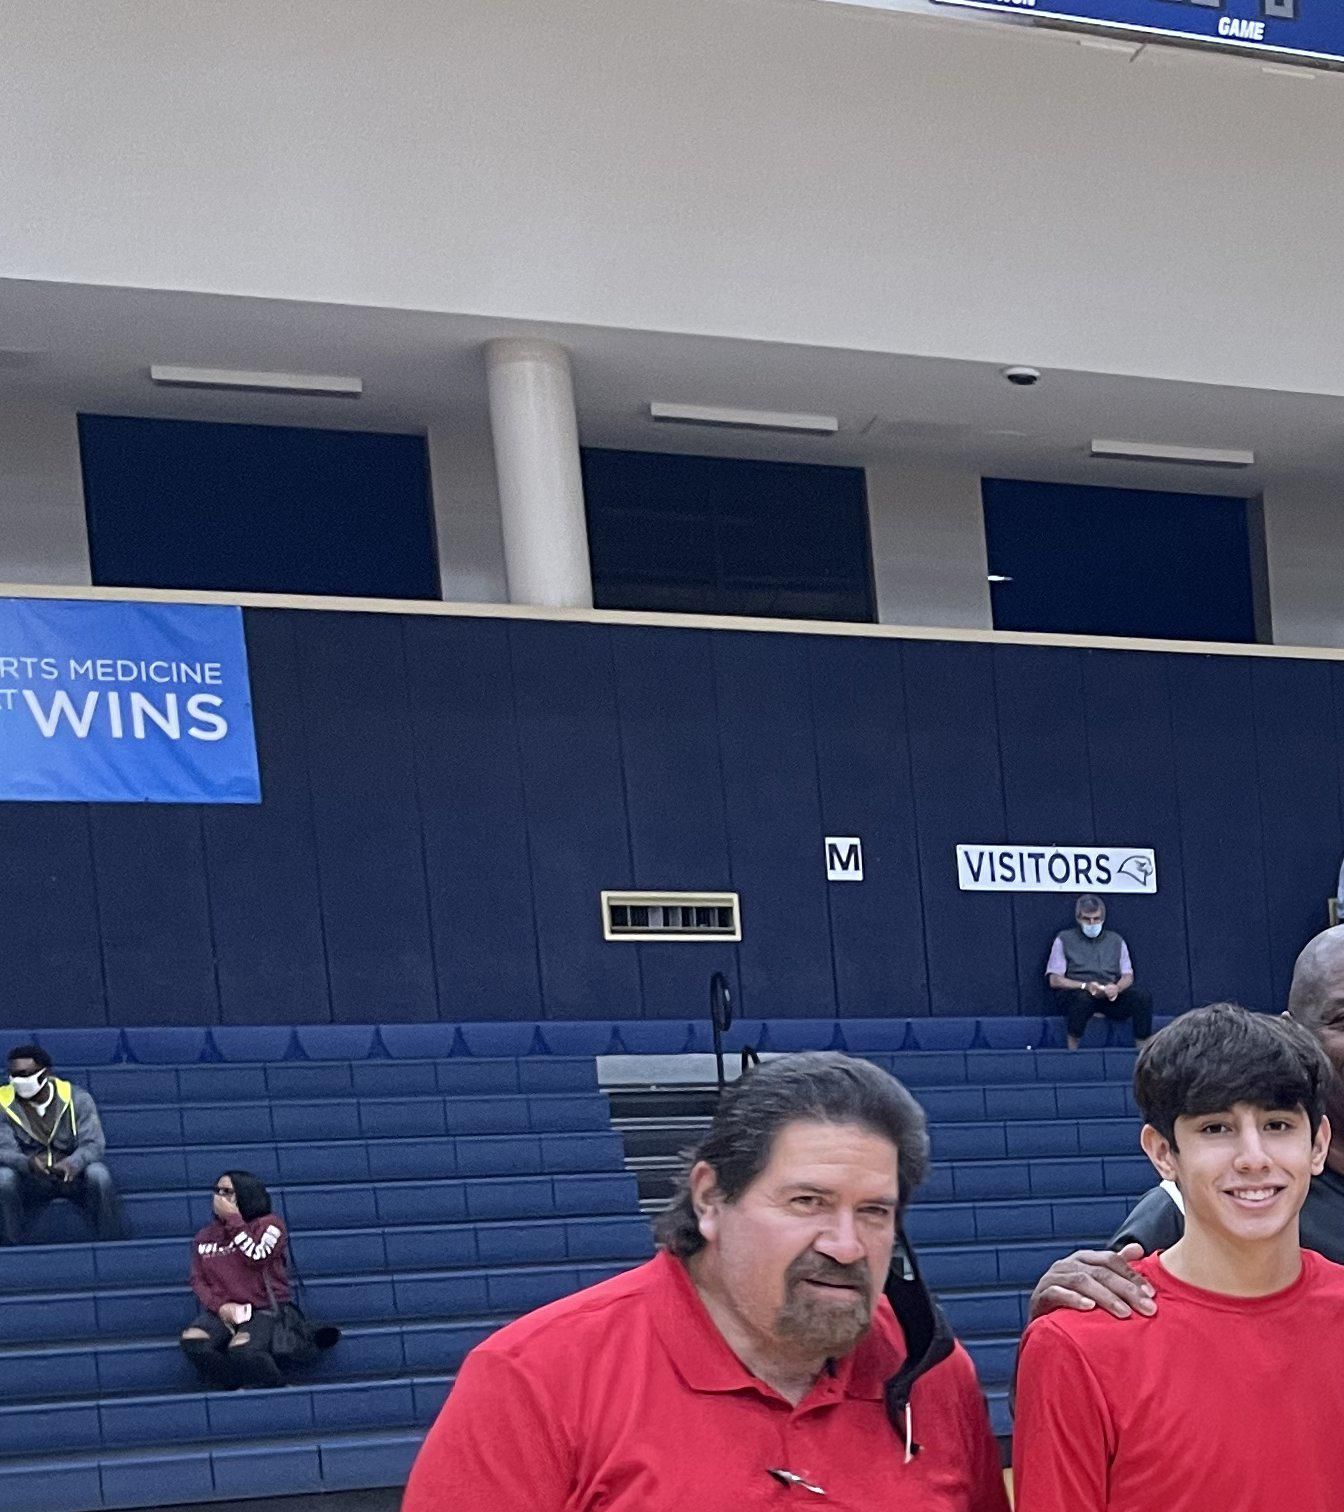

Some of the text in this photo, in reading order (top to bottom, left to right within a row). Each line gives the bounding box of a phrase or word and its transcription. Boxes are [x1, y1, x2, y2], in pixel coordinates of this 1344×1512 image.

[1218, 16, 1265, 41] GAME
[70, 659, 223, 684] MEDICINE
[23, 690, 228, 741] WINS
[829, 843, 860, 872] M
[964, 850, 1112, 886] VISITORS
